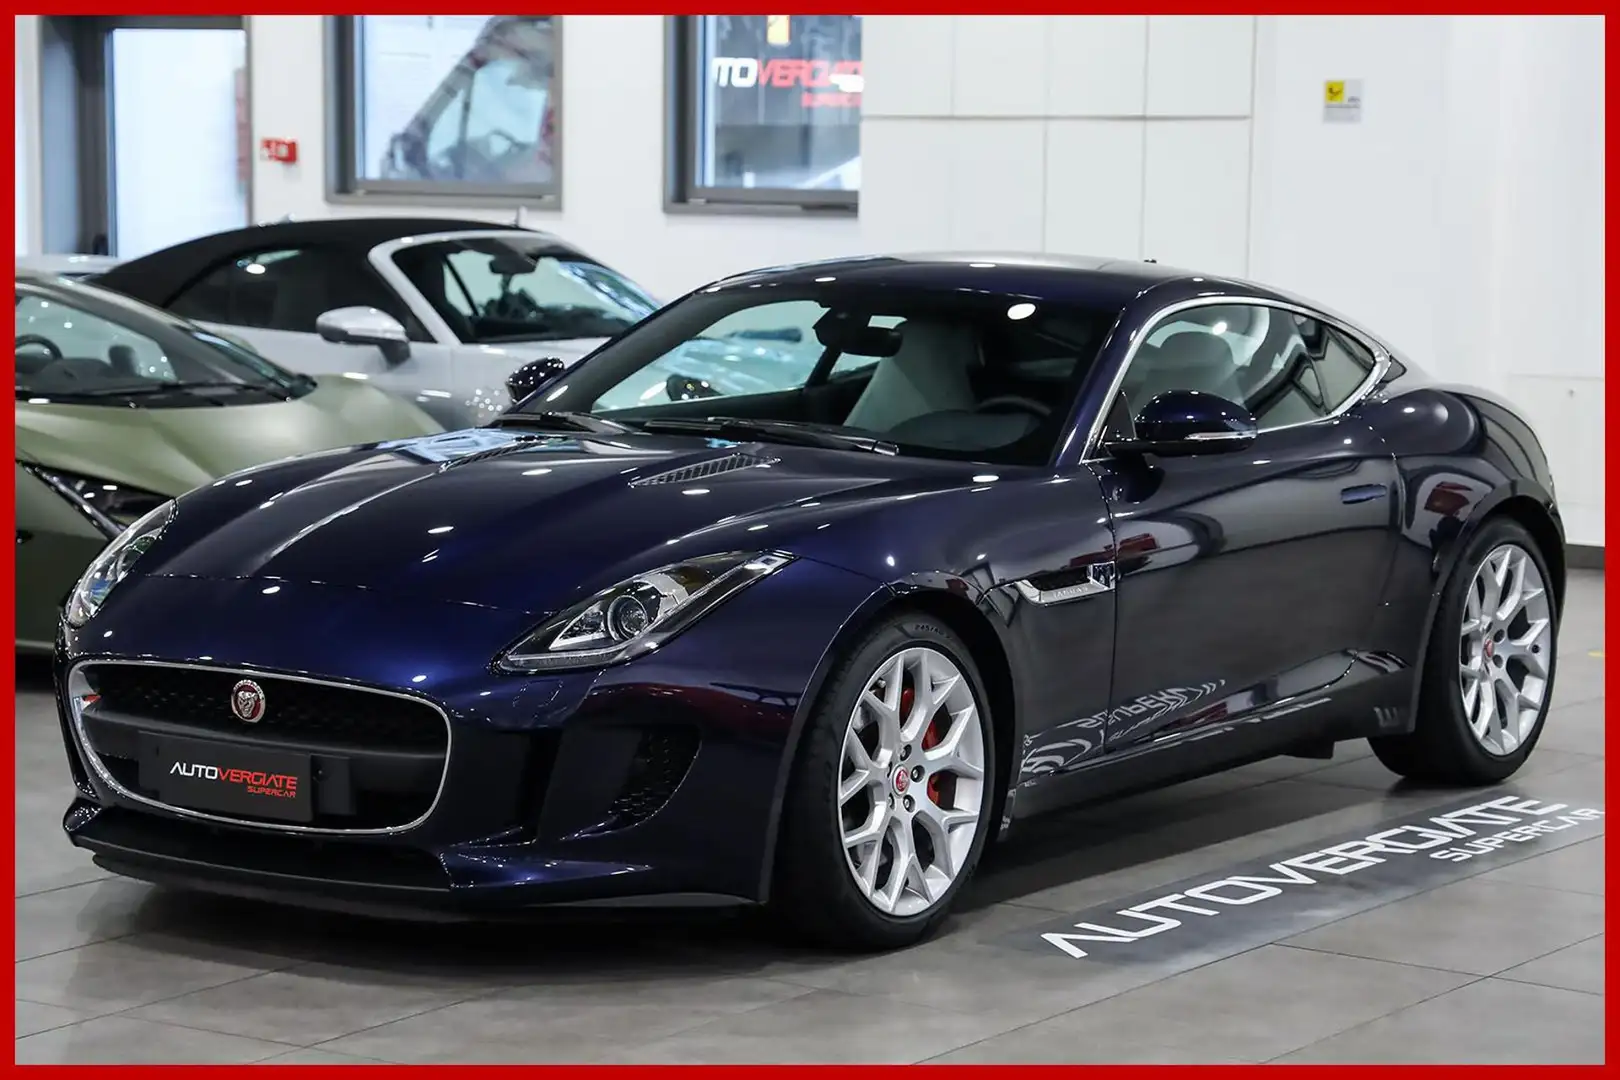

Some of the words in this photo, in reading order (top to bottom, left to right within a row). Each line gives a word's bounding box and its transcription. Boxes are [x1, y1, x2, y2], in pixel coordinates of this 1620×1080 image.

[170, 761, 298, 790] AUTOVERGIATE
[247, 785, 297, 798] SUPERCAR
[1429, 808, 1605, 862] SUPERCAR
[1041, 796, 1568, 958] AUTOVERGIATE
